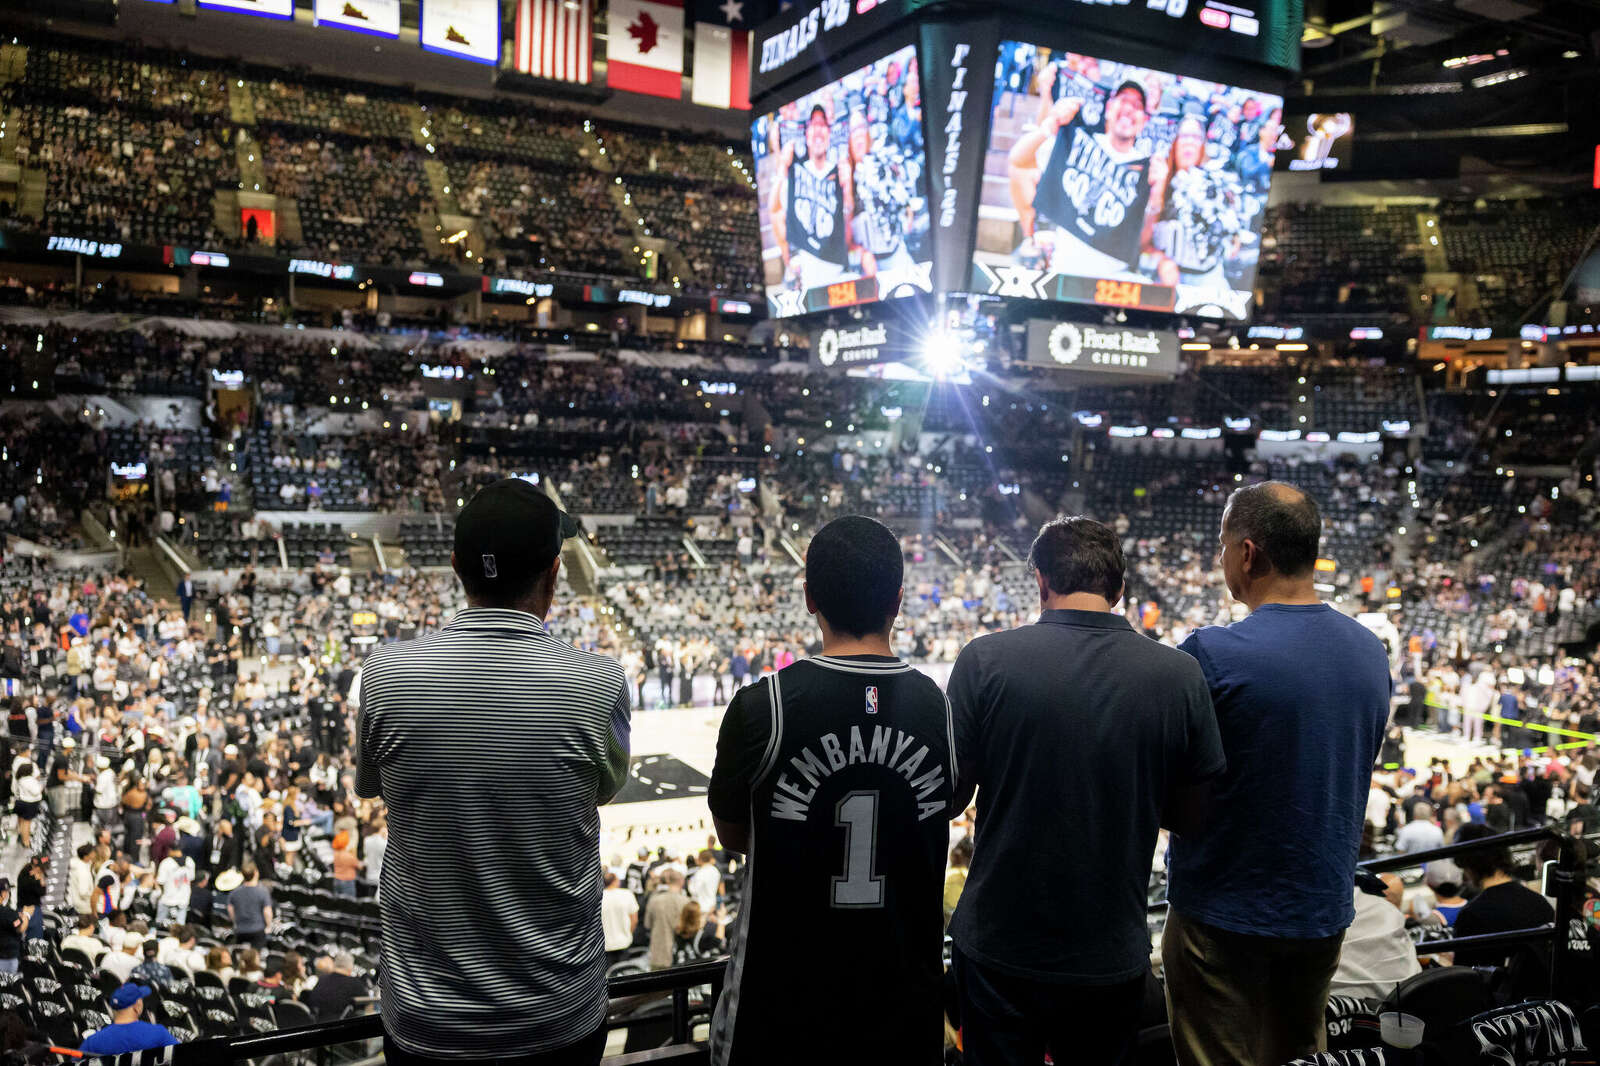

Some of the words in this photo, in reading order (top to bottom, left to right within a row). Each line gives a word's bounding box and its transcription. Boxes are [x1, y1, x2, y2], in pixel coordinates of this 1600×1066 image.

[760, 7, 820, 73] FINALS
[945, 44, 971, 174] FINALS
[47, 236, 97, 256] FINALS
[1083, 328, 1121, 350] Frost
[1121, 331, 1160, 353] Bank
[1091, 351, 1148, 367] CENTER
[770, 724, 947, 822] WEMBANYAMA
[829, 789, 886, 908] 1
